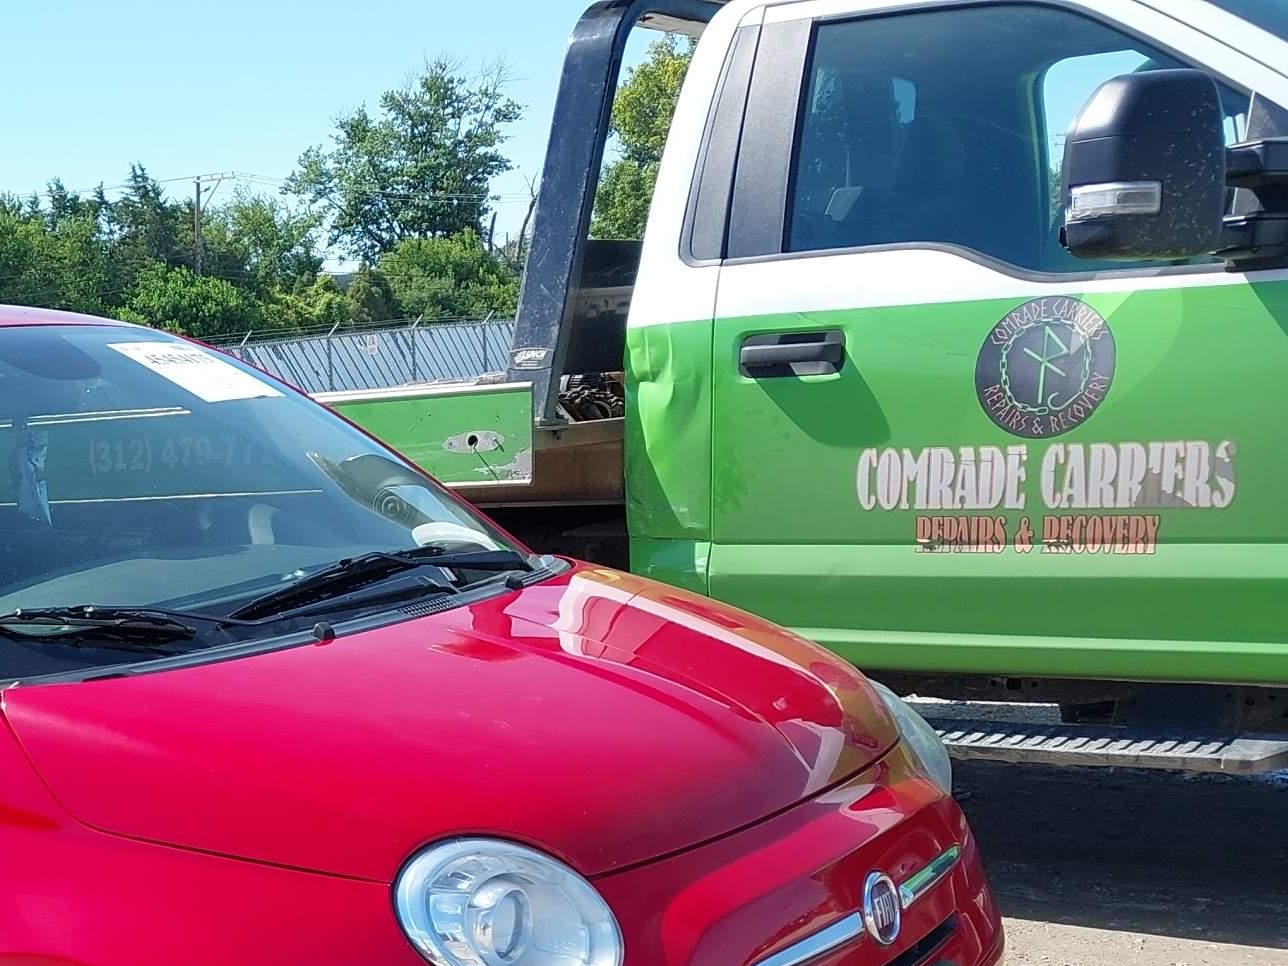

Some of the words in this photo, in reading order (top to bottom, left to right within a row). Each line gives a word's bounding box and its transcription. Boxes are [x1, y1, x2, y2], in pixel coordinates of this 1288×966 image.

[991, 299, 1048, 345] COMRADE
[1053, 299, 1110, 340] CARRIERS
[983, 384, 1030, 431] REPAIRS
[1031, 417, 1044, 435] &
[1049, 372, 1110, 433] RECOVERY
[88, 434, 153, 477] (312)
[856, 444, 1028, 510] COMRADE
[915, 515, 1007, 554] REPAIRS
[1014, 516, 1034, 554] &
[1040, 514, 1160, 555] RECOVERY
[873, 891, 895, 929] FIAT
